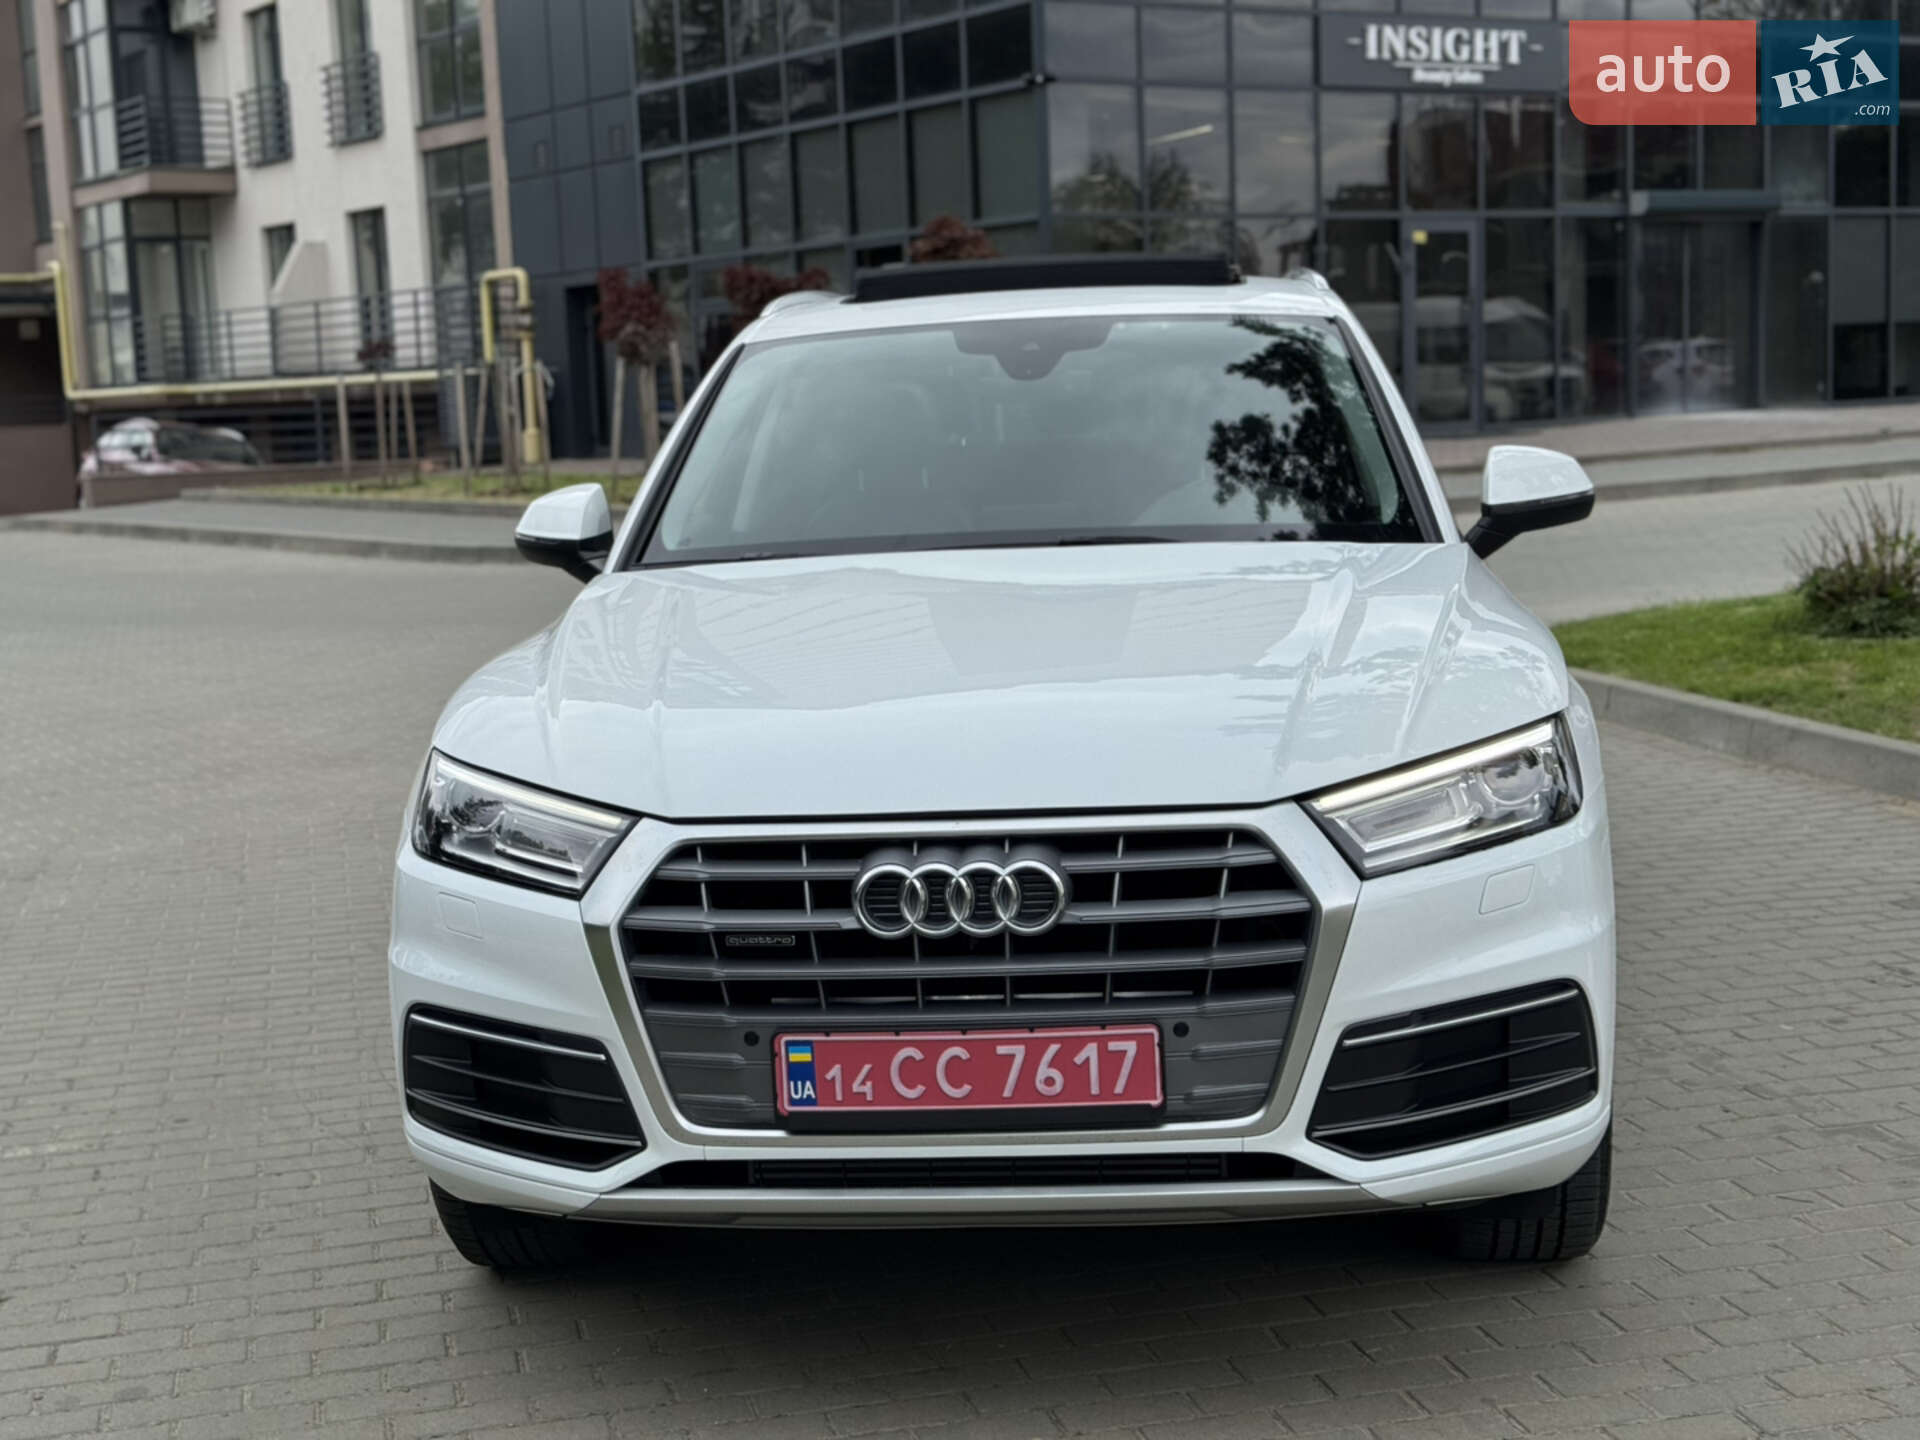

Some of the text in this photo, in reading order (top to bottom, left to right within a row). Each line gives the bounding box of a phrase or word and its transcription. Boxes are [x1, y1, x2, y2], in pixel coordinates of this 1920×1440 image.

[1365, 23, 1528, 65] INSIGHT
[790, 1080, 816, 1100] UA
[825, 1040, 1138, 1101] 14 CC 7617
